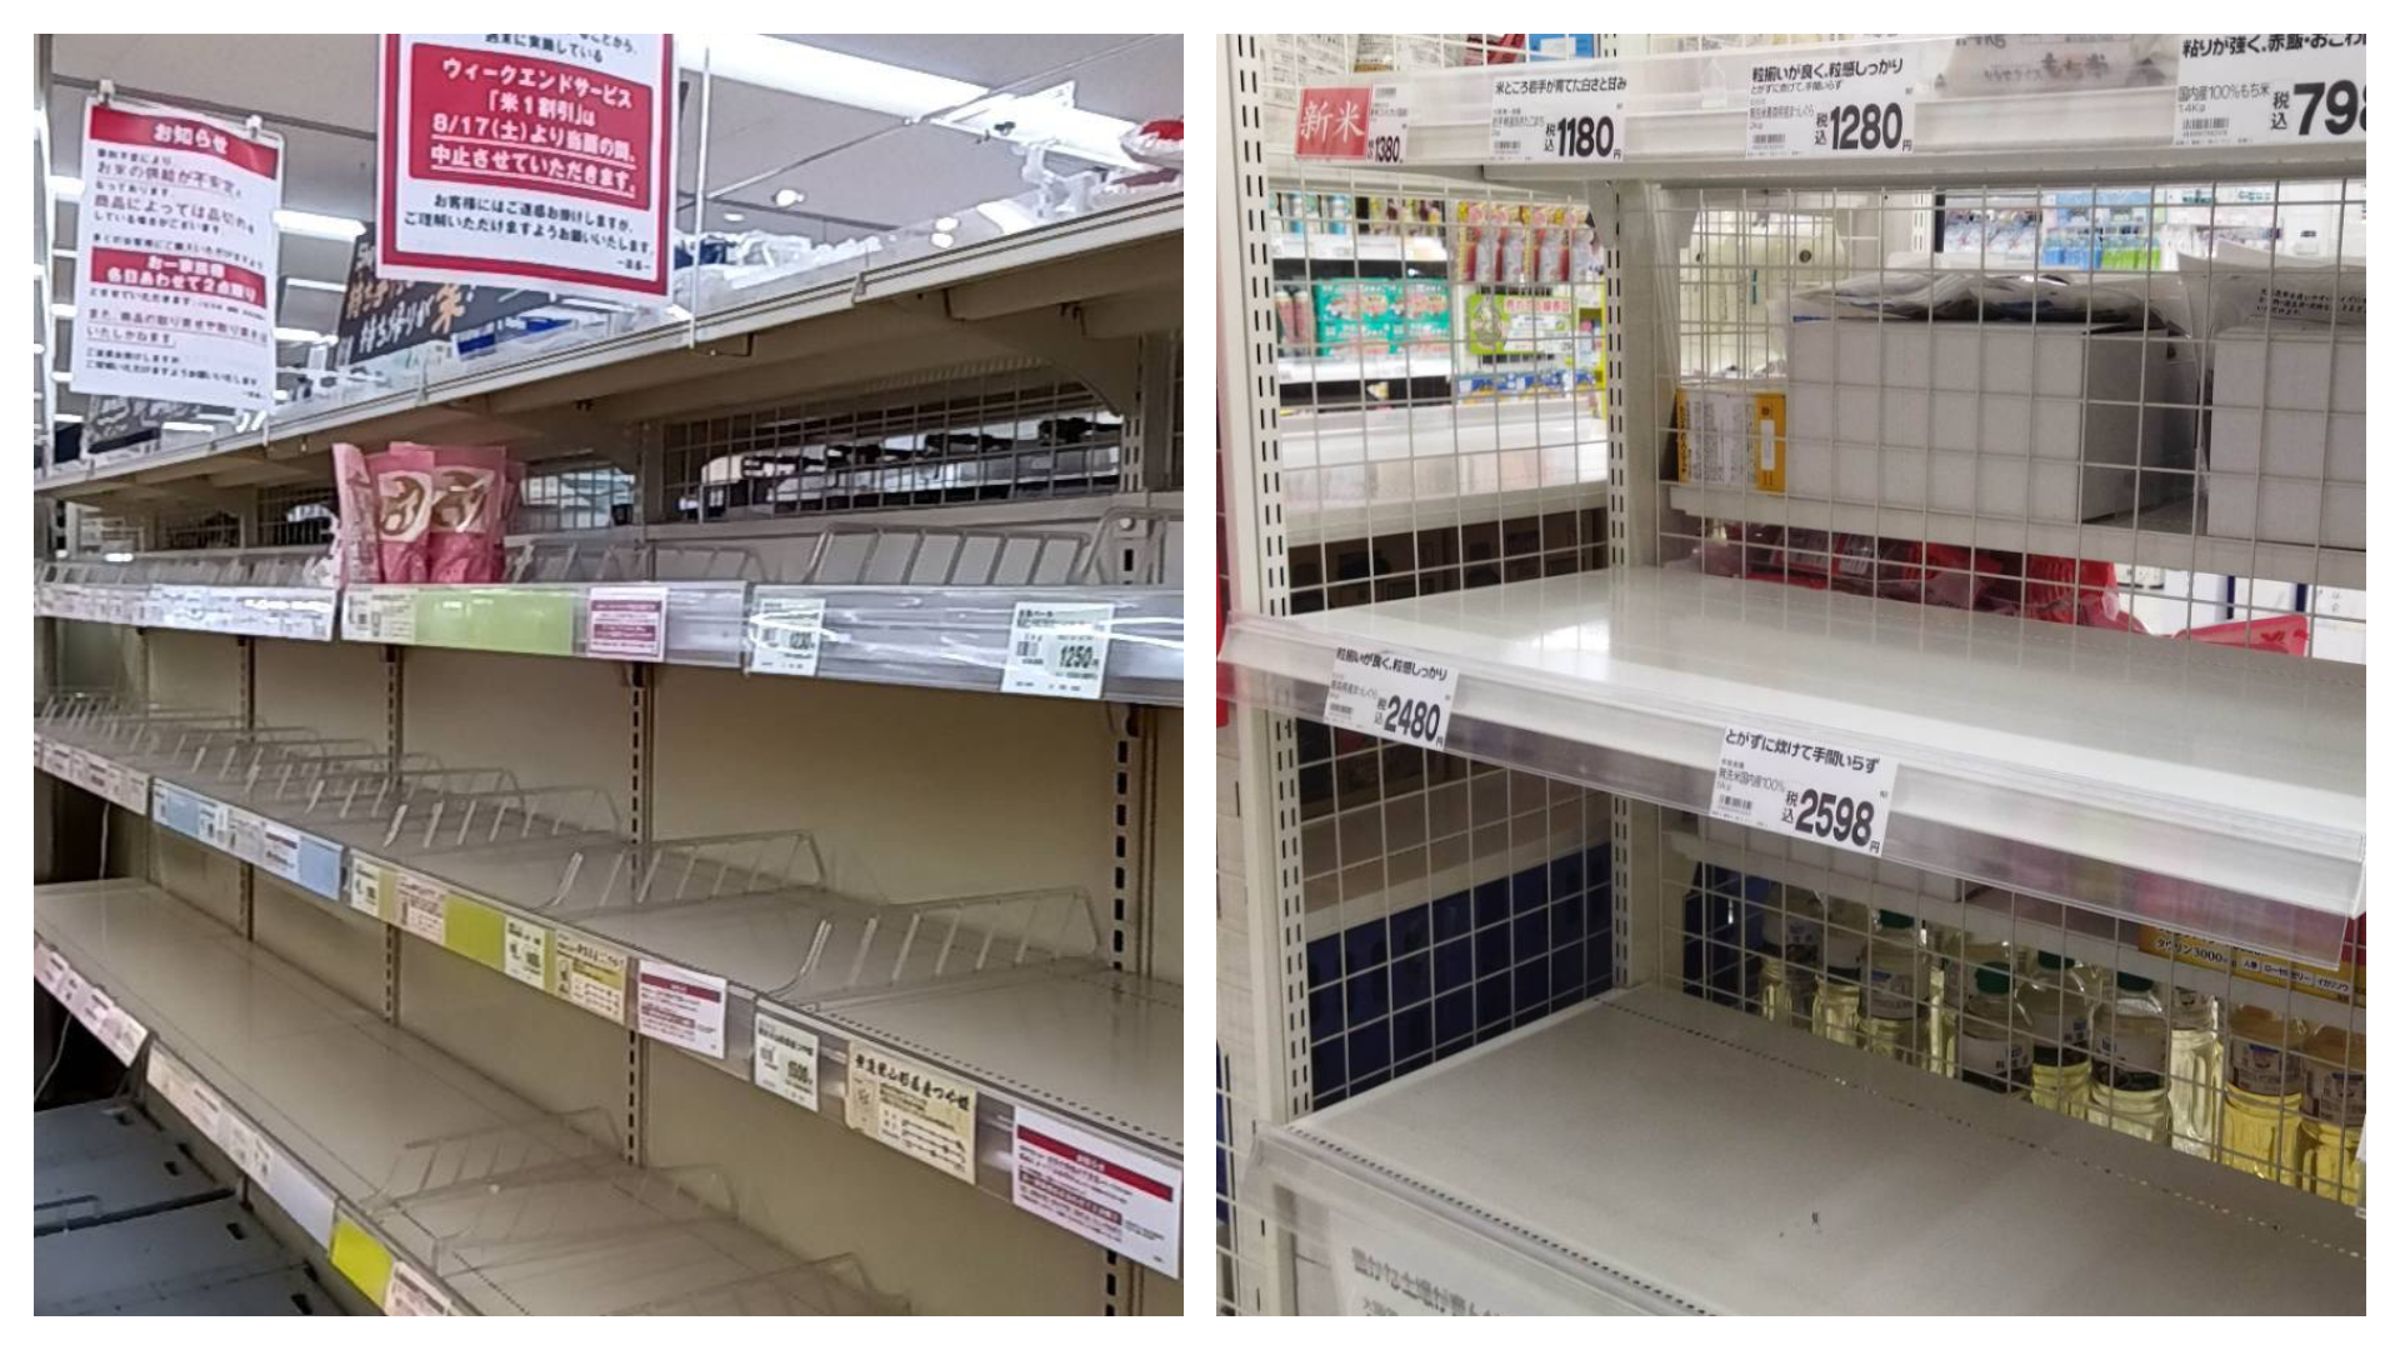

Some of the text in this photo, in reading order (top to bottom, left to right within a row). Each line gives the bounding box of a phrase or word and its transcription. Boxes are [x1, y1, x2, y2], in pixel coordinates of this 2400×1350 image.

[442, 58, 633, 109] ウィークエンドサービス
[1301, 101, 1365, 143] 新米
[1814, 102, 1912, 152] 税込 1280 円
[2270, 91, 2289, 130] 税込
[153, 122, 228, 155] お知らせ
[1375, 136, 1400, 163] 1380
[1544, 123, 1556, 152] 税込
[1557, 115, 1615, 158] 1180
[430, 143, 636, 192] 中止させていただきます。
[1384, 694, 1440, 742] 2480
[1726, 728, 1881, 774] とがずに炊けて手間いらず
[1781, 788, 1881, 853] 税込 2598 円
